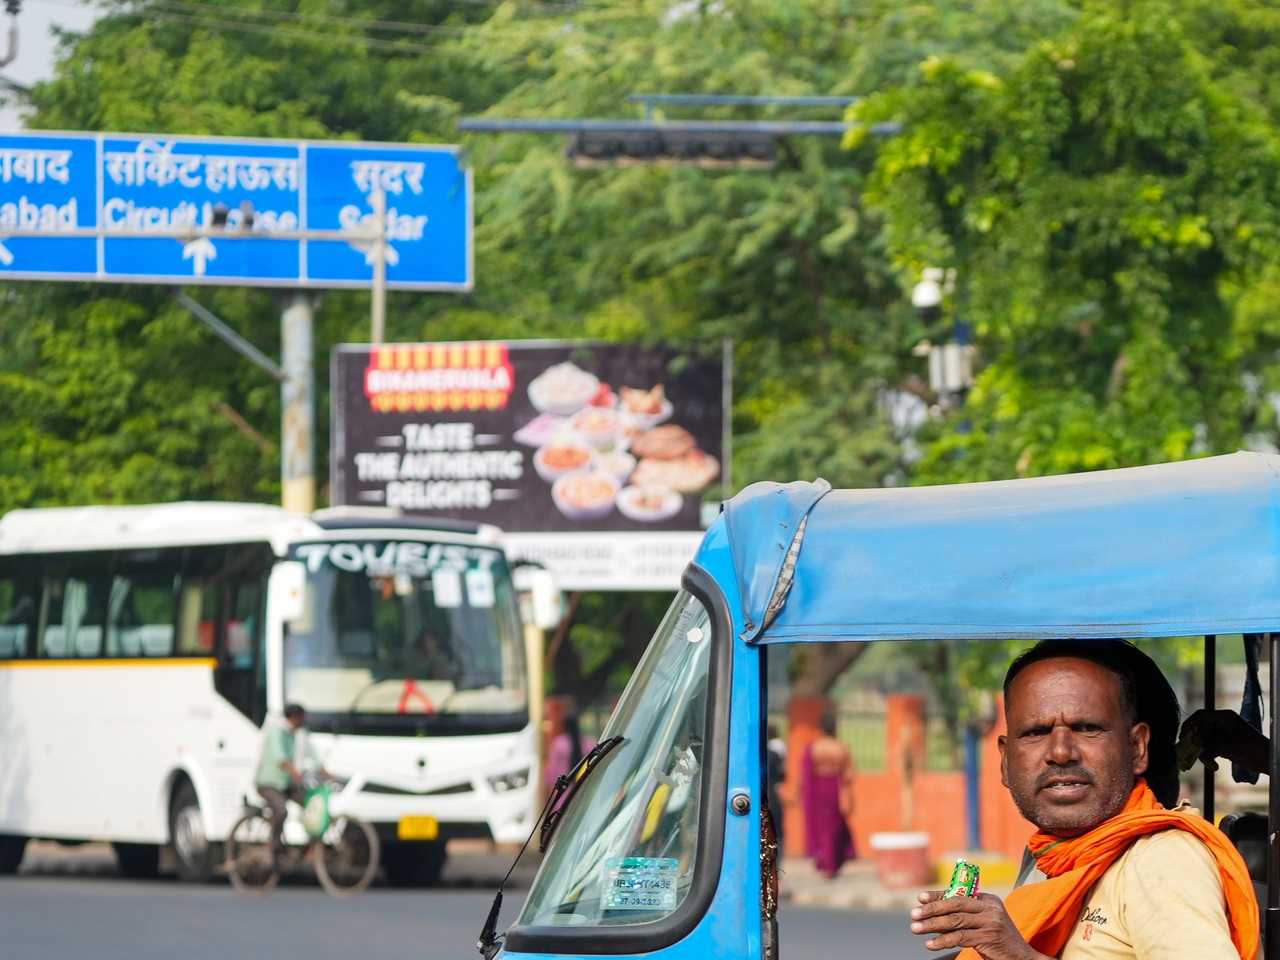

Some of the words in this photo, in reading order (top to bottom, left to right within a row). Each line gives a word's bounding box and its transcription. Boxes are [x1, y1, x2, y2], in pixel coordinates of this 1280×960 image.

[350, 161, 425, 195] सदर
[104, 198, 198, 231] Circuit
[402, 423, 475, 451] TASTE
[354, 452, 400, 482] THE
[401, 450, 524, 480] AUTHENTIC
[386, 480, 492, 509] DELIGHTS
[296, 541, 500, 574] TOURIST
